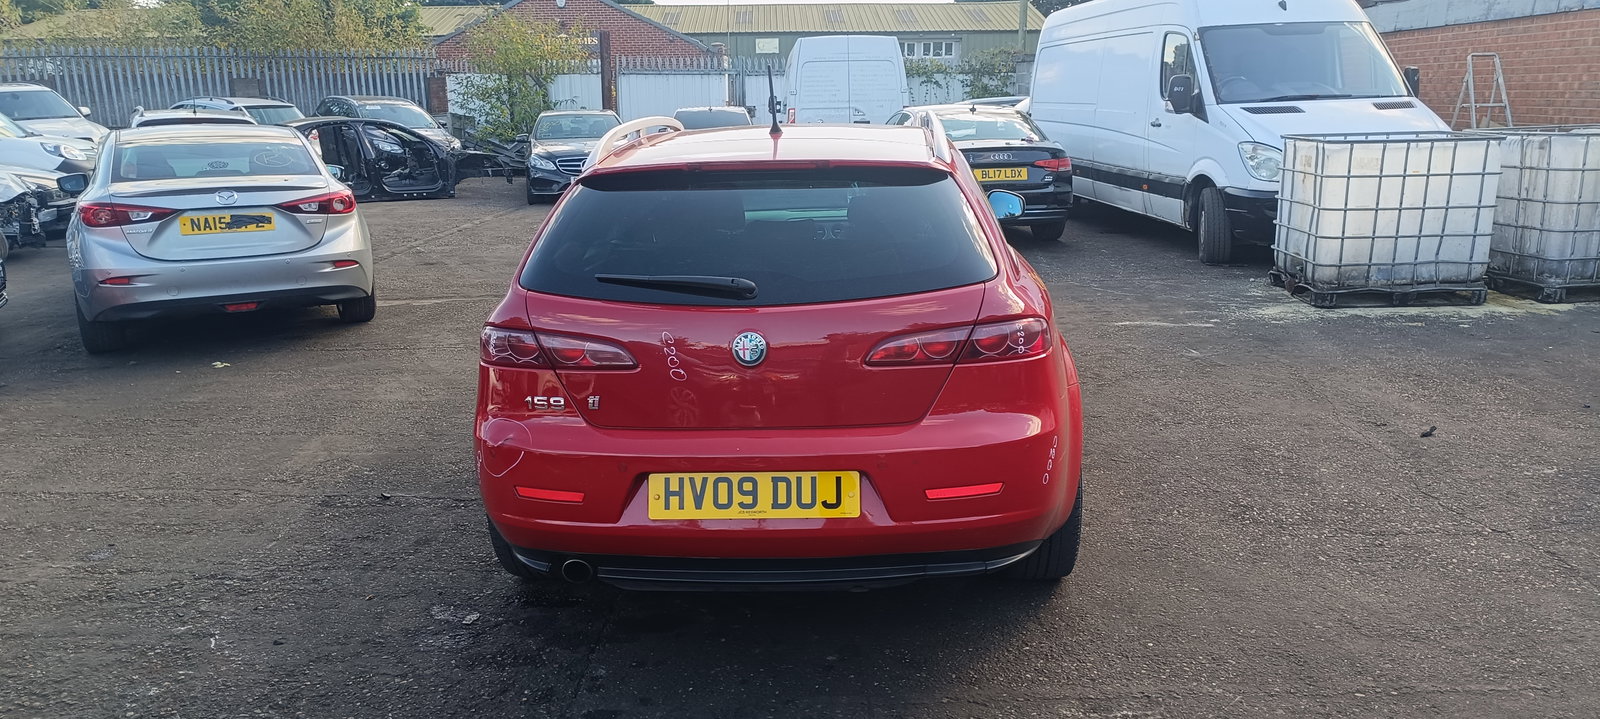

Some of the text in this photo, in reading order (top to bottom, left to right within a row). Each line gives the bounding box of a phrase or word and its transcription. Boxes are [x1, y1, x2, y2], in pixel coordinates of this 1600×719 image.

[981, 169, 1023, 179] BL17 LDX
[661, 331, 688, 381] C200
[524, 395, 565, 410] 159
[664, 476, 842, 511] HV09 DUJ
